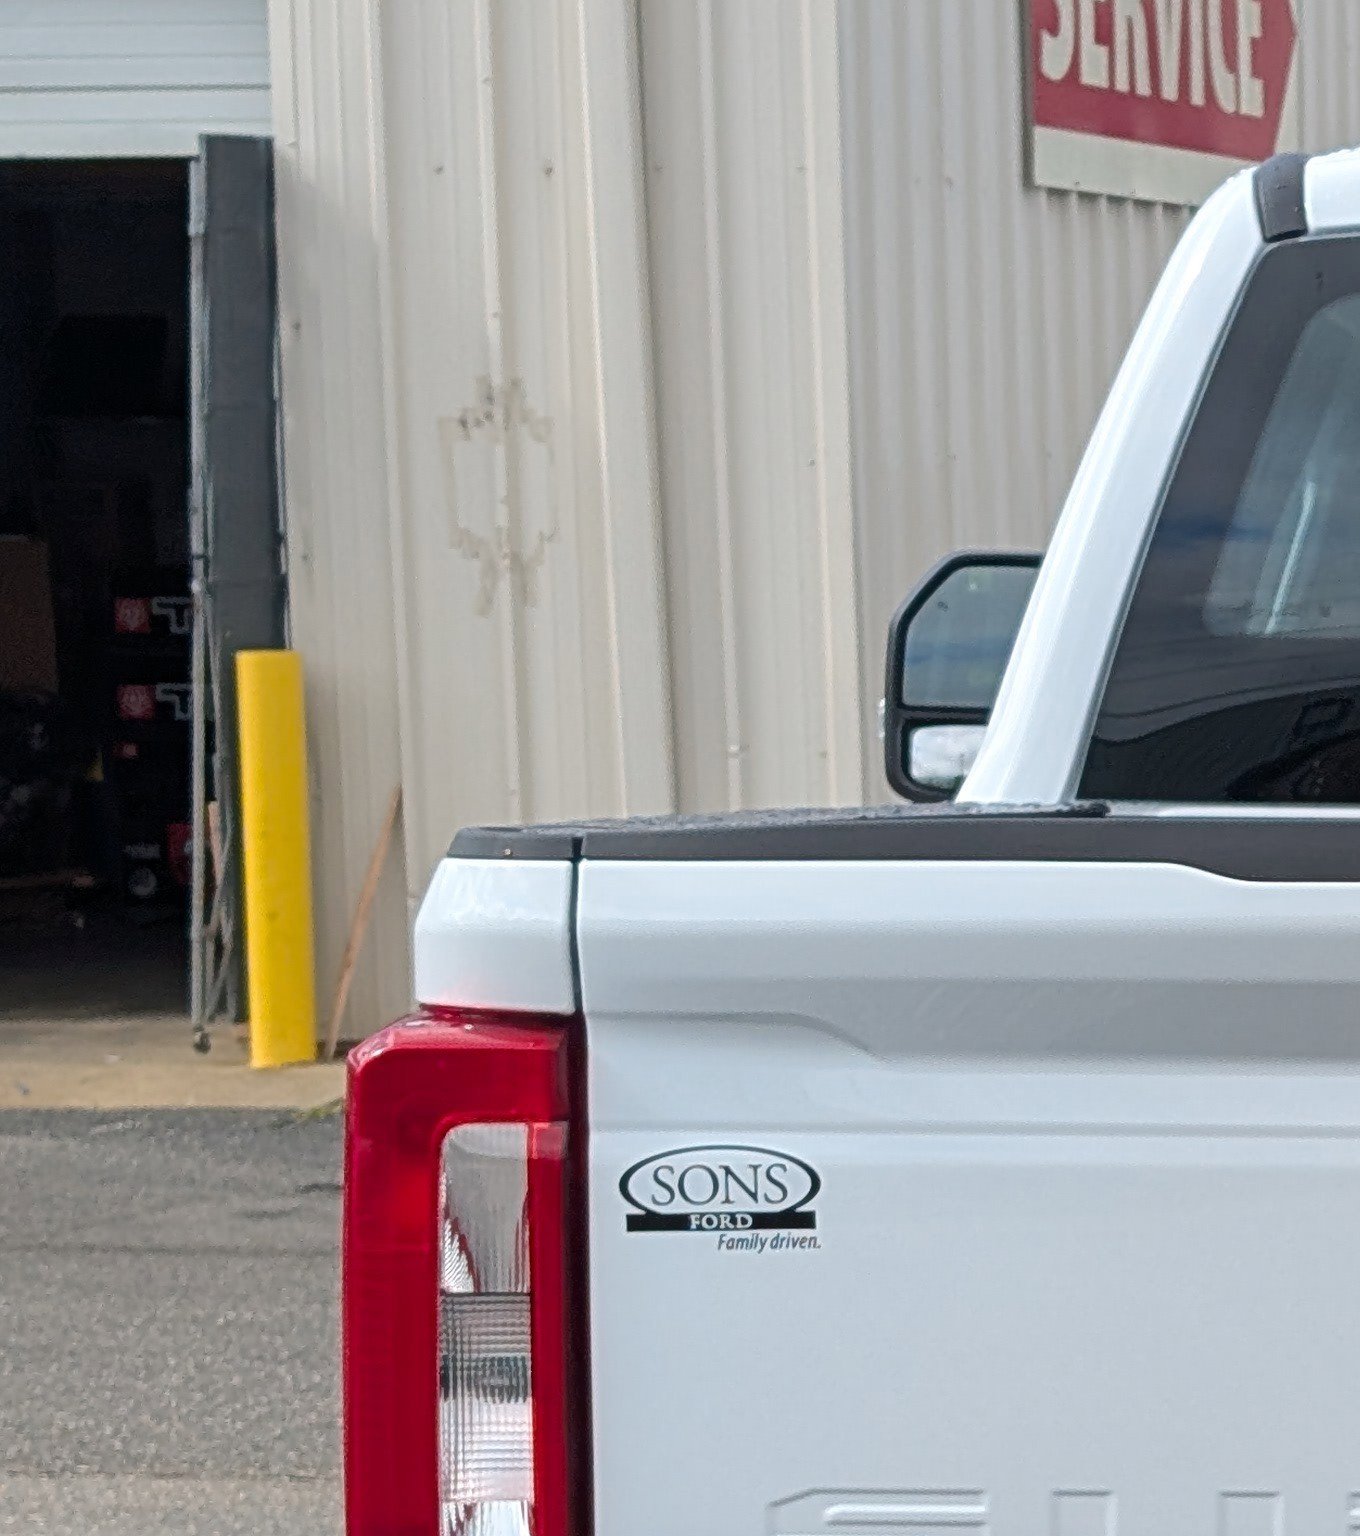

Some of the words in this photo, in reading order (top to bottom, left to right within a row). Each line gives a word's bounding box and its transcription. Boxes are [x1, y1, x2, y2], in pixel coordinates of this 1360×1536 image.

[651, 1163, 788, 1206] SONS
[689, 1213, 753, 1230] FORD
[717, 1233, 769, 1254] Family
[769, 1231, 822, 1250] driven.
